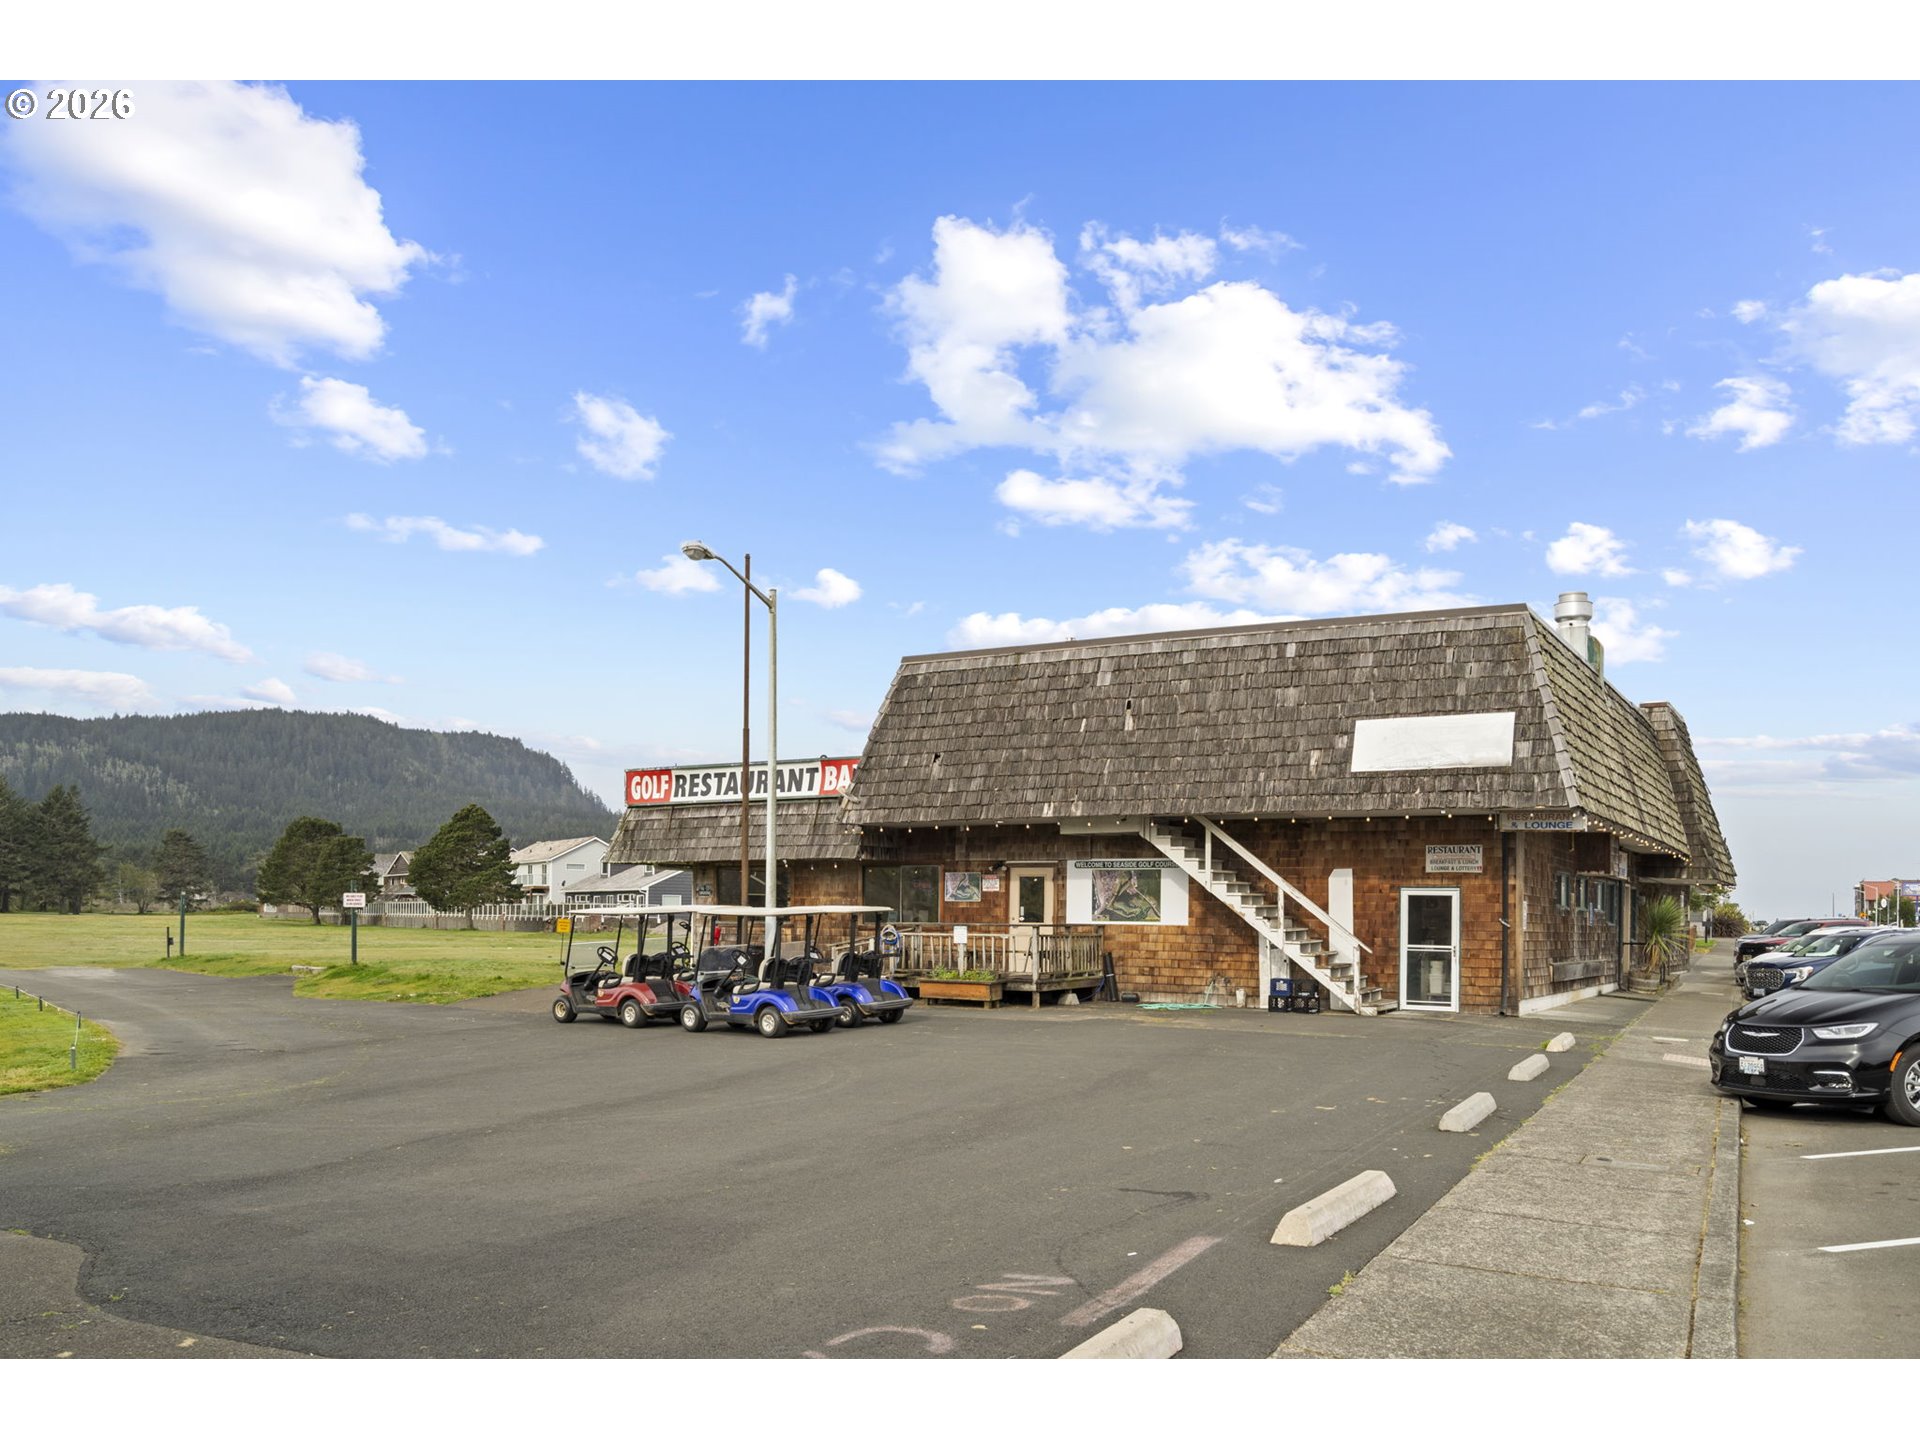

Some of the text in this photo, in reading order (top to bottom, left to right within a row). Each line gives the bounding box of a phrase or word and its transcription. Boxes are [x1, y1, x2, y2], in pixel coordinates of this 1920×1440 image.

[630, 764, 858, 801] GOLF RESTAURANT BA
[1524, 821, 1573, 829] LOUNGE
[1427, 845, 1481, 854] RESTAURANT
